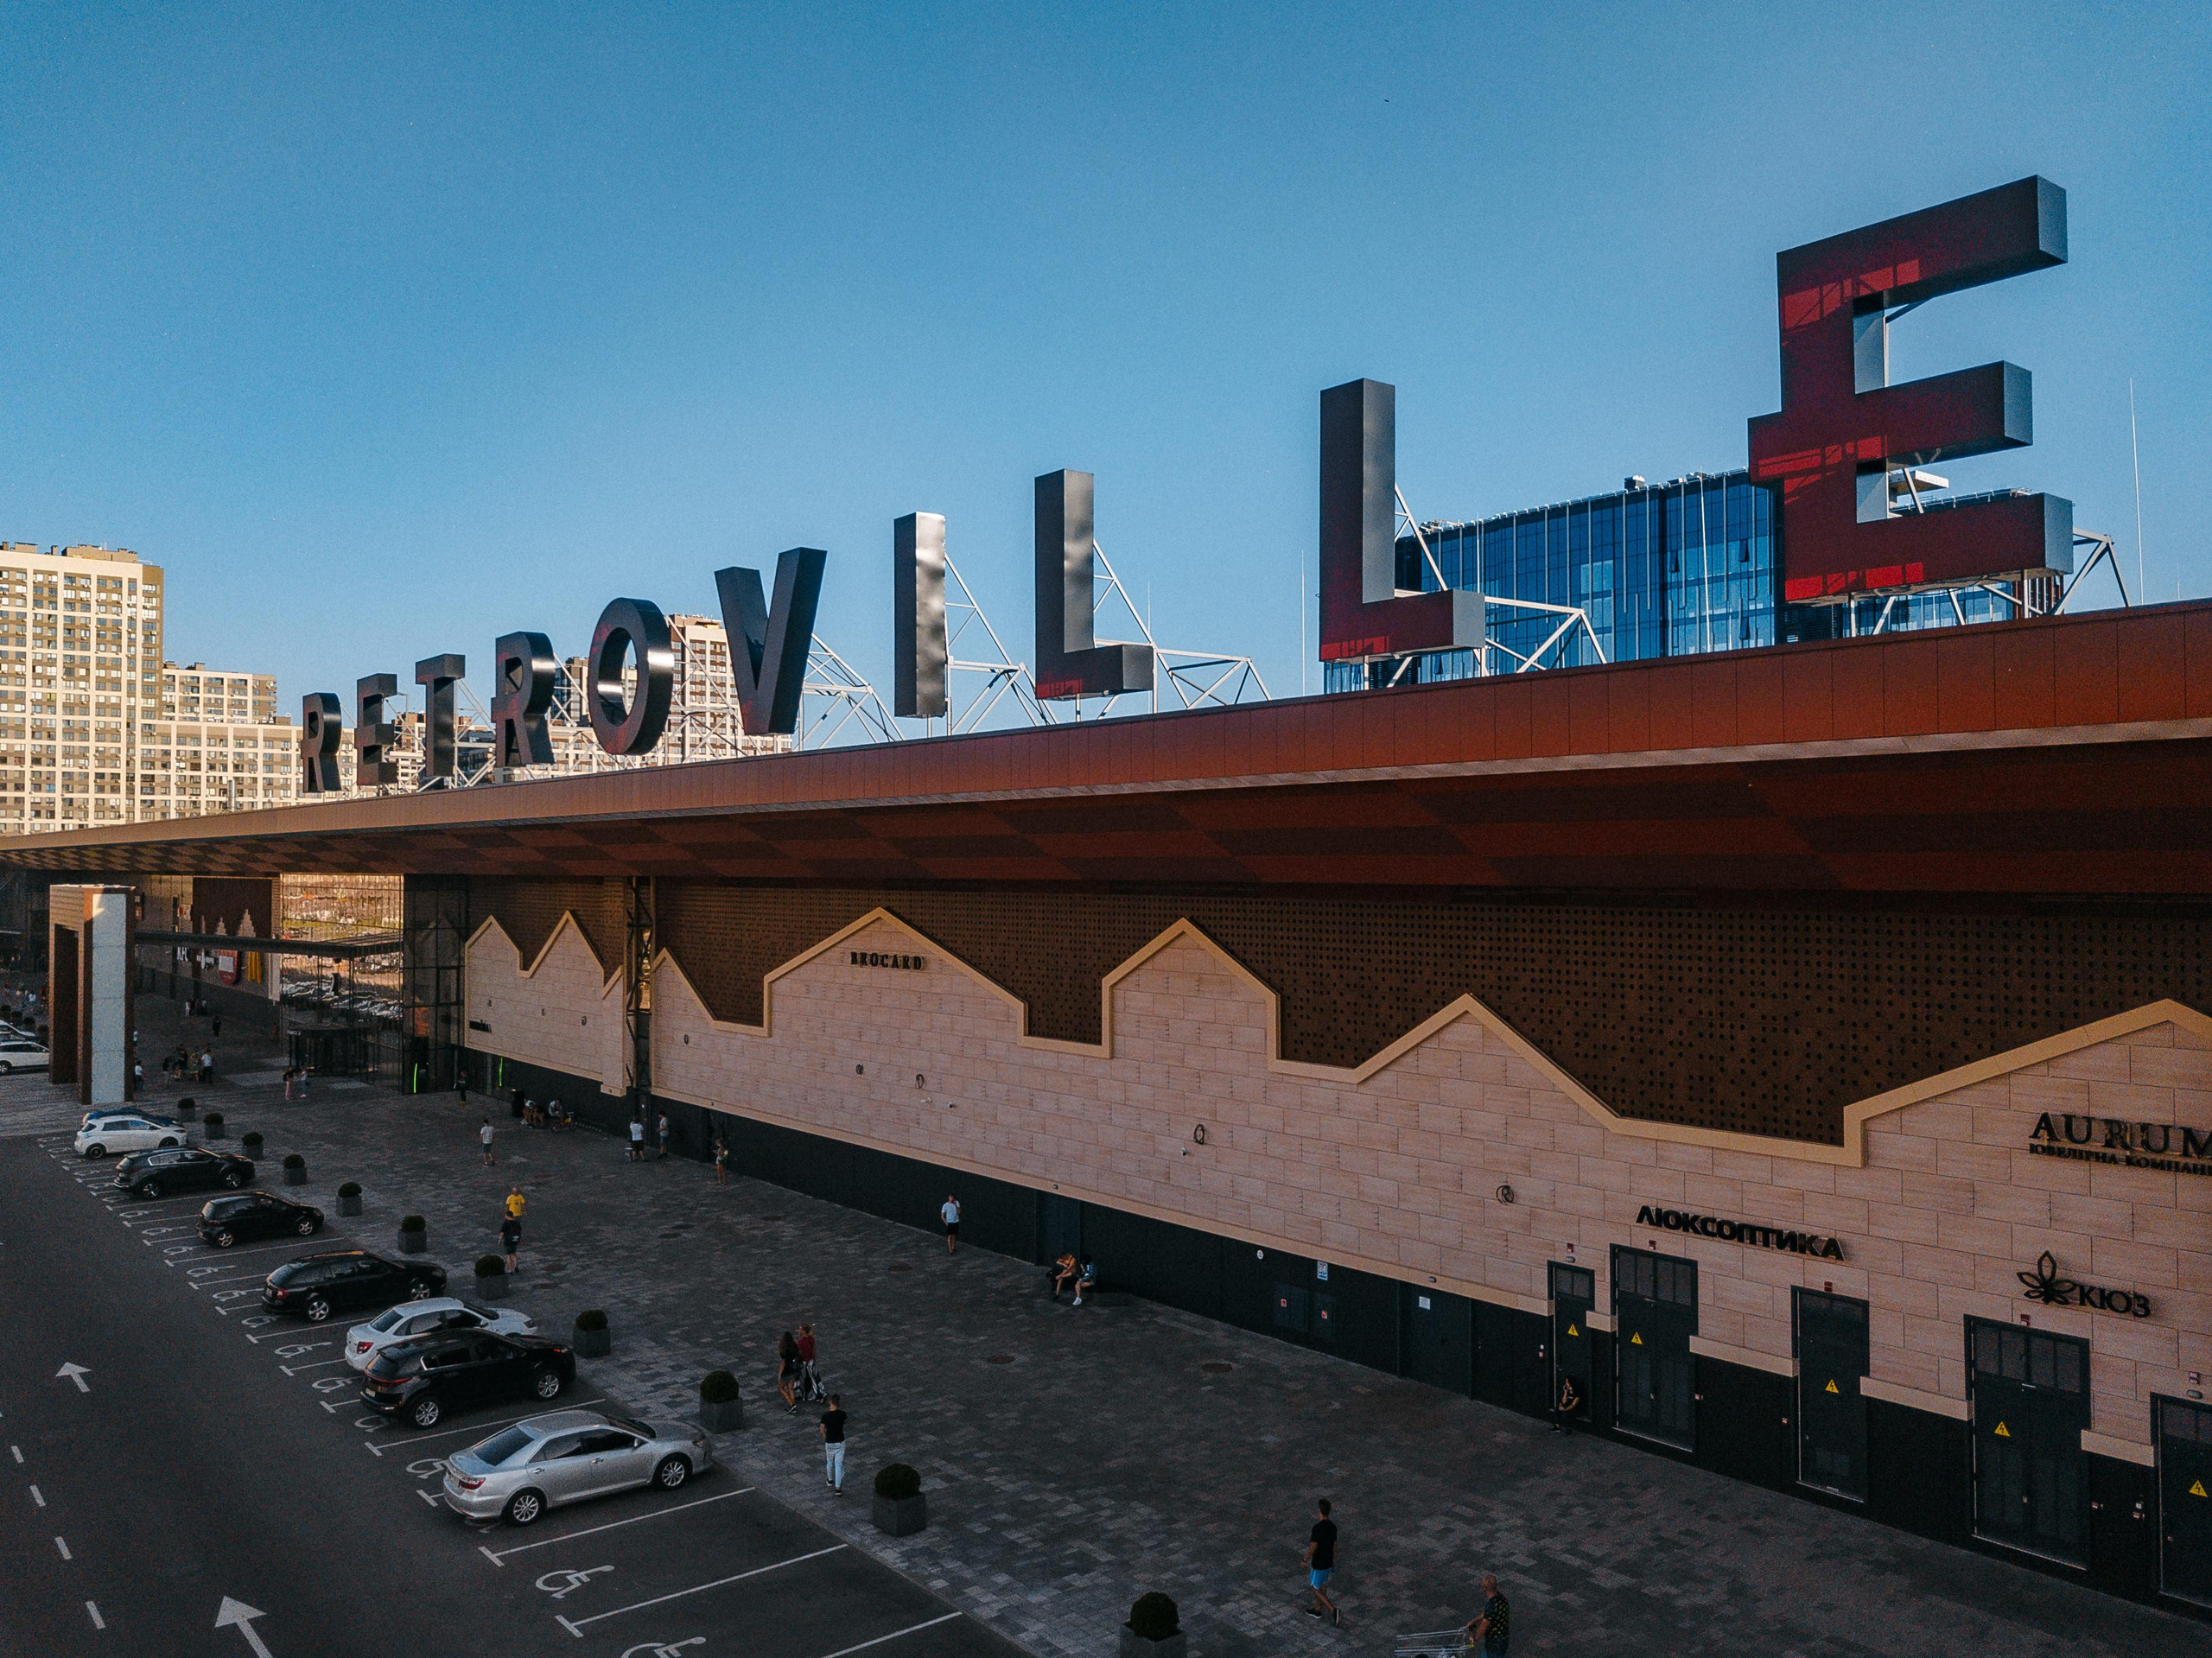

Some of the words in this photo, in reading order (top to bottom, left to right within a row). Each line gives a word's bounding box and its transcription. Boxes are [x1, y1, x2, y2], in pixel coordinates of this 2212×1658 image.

[302, 175, 2074, 793] RETROVILLE
[850, 951, 925, 970] BROCARD
[2028, 1111, 2212, 1159] AURUM
[1636, 1204, 1846, 1261] ЛЮКСОПТИКА
[2077, 1284, 2152, 1318] КЮЗ
